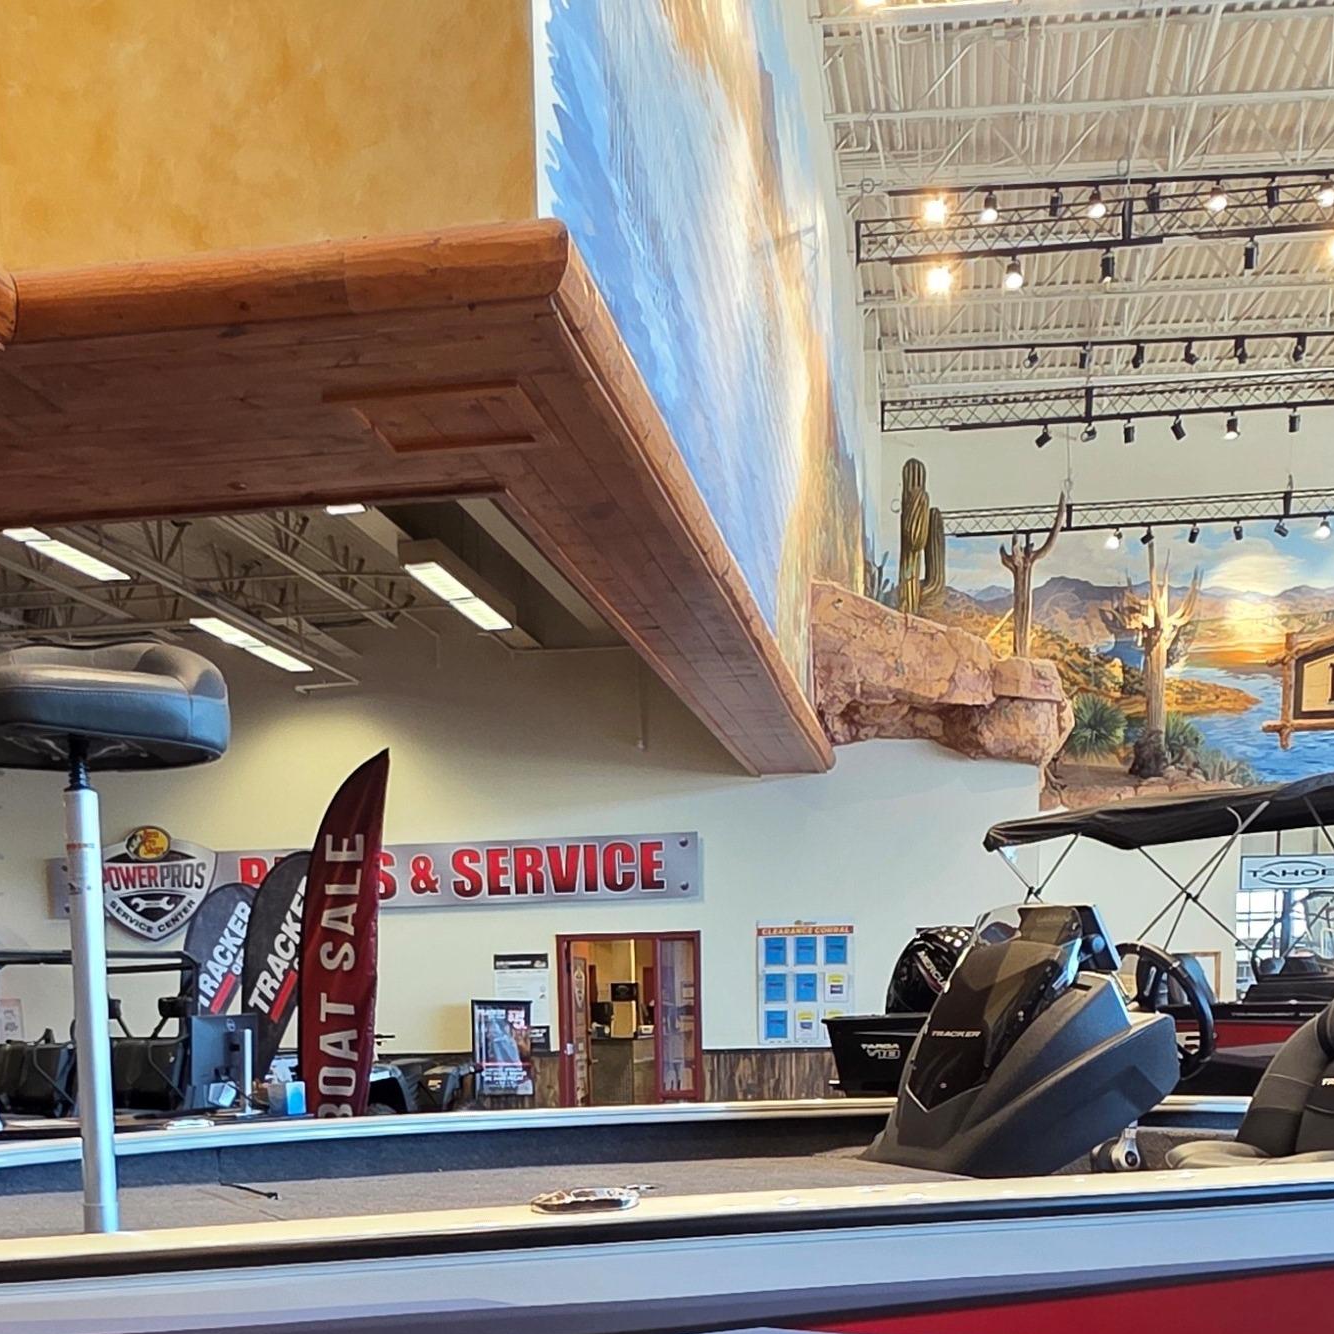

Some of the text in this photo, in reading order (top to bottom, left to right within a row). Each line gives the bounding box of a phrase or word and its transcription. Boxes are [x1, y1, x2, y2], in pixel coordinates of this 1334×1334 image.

[411, 856, 440, 894] &
[452, 842, 665, 898] SERVICE
[110, 900, 195, 933] SERVICE CENTER
[320, 834, 365, 972] SALE
[199, 900, 252, 1008] TRACKER
[917, 950, 949, 989] MERCU
[931, 1030, 981, 1038] TRACKER
